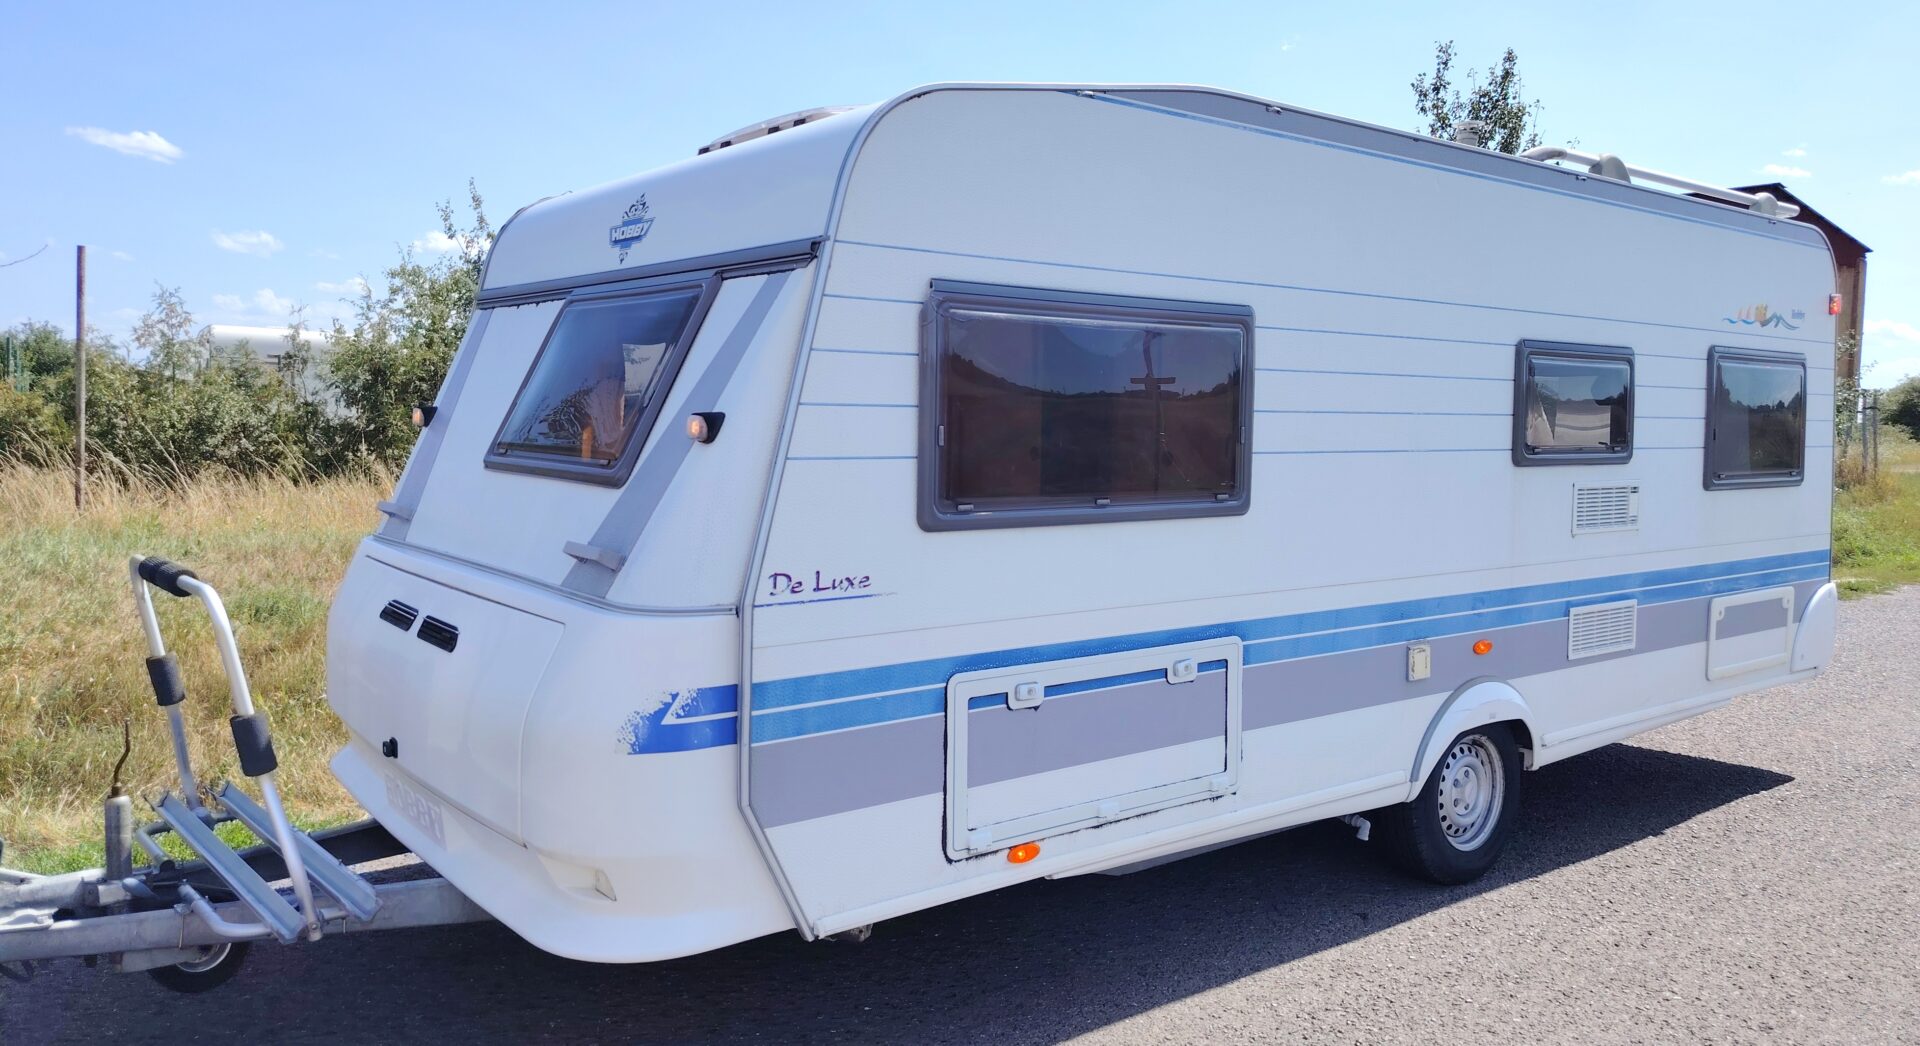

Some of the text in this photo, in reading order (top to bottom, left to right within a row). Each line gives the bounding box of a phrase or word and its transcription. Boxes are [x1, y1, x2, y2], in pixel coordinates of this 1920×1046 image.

[611, 222, 653, 242] HOBBY
[768, 571, 871, 596] De Luxe
